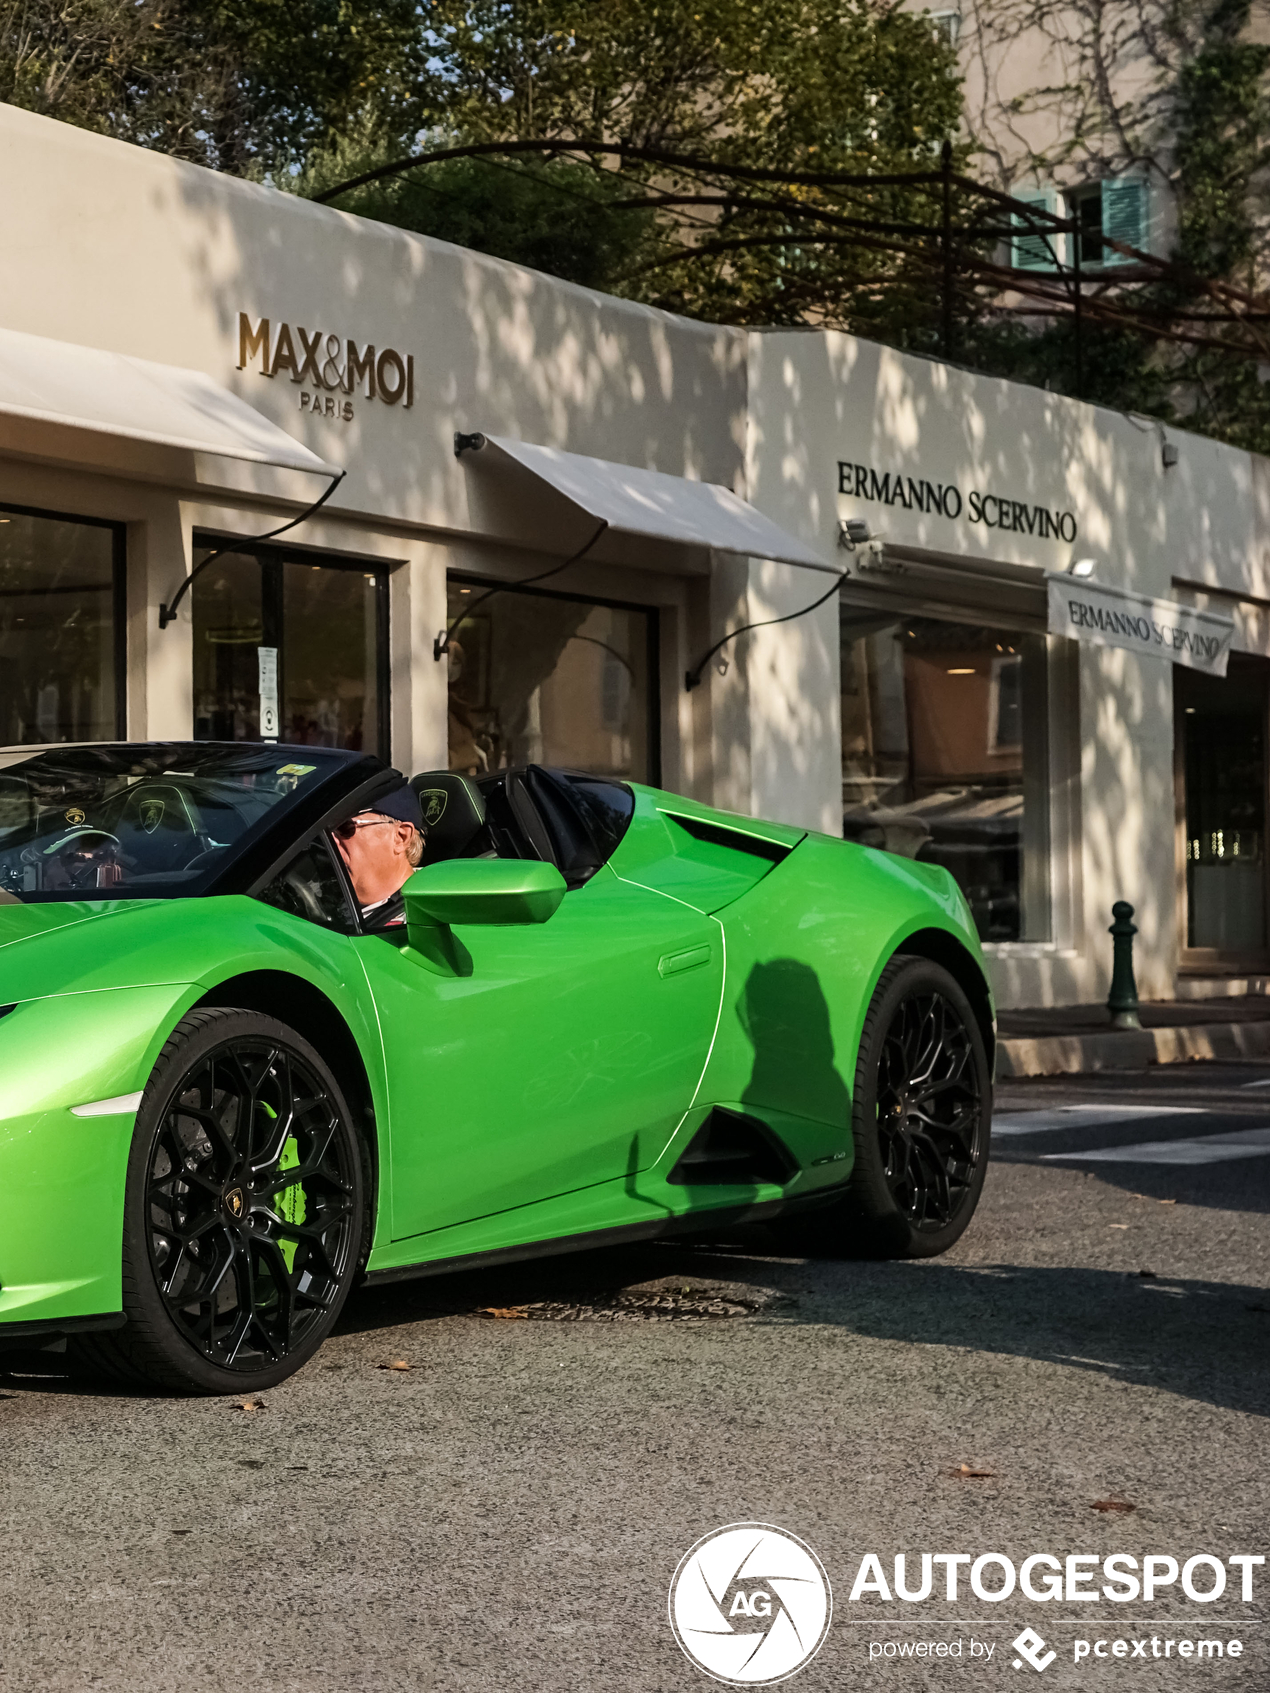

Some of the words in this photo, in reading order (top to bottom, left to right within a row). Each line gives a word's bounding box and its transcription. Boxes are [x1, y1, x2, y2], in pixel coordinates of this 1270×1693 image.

[235, 311, 414, 409] MAX&MOI
[298, 391, 355, 422] PARIS
[837, 460, 962, 520] ERMANNO
[968, 491, 1077, 543] SCERVINO
[1068, 600, 1150, 642] ERMANNO
